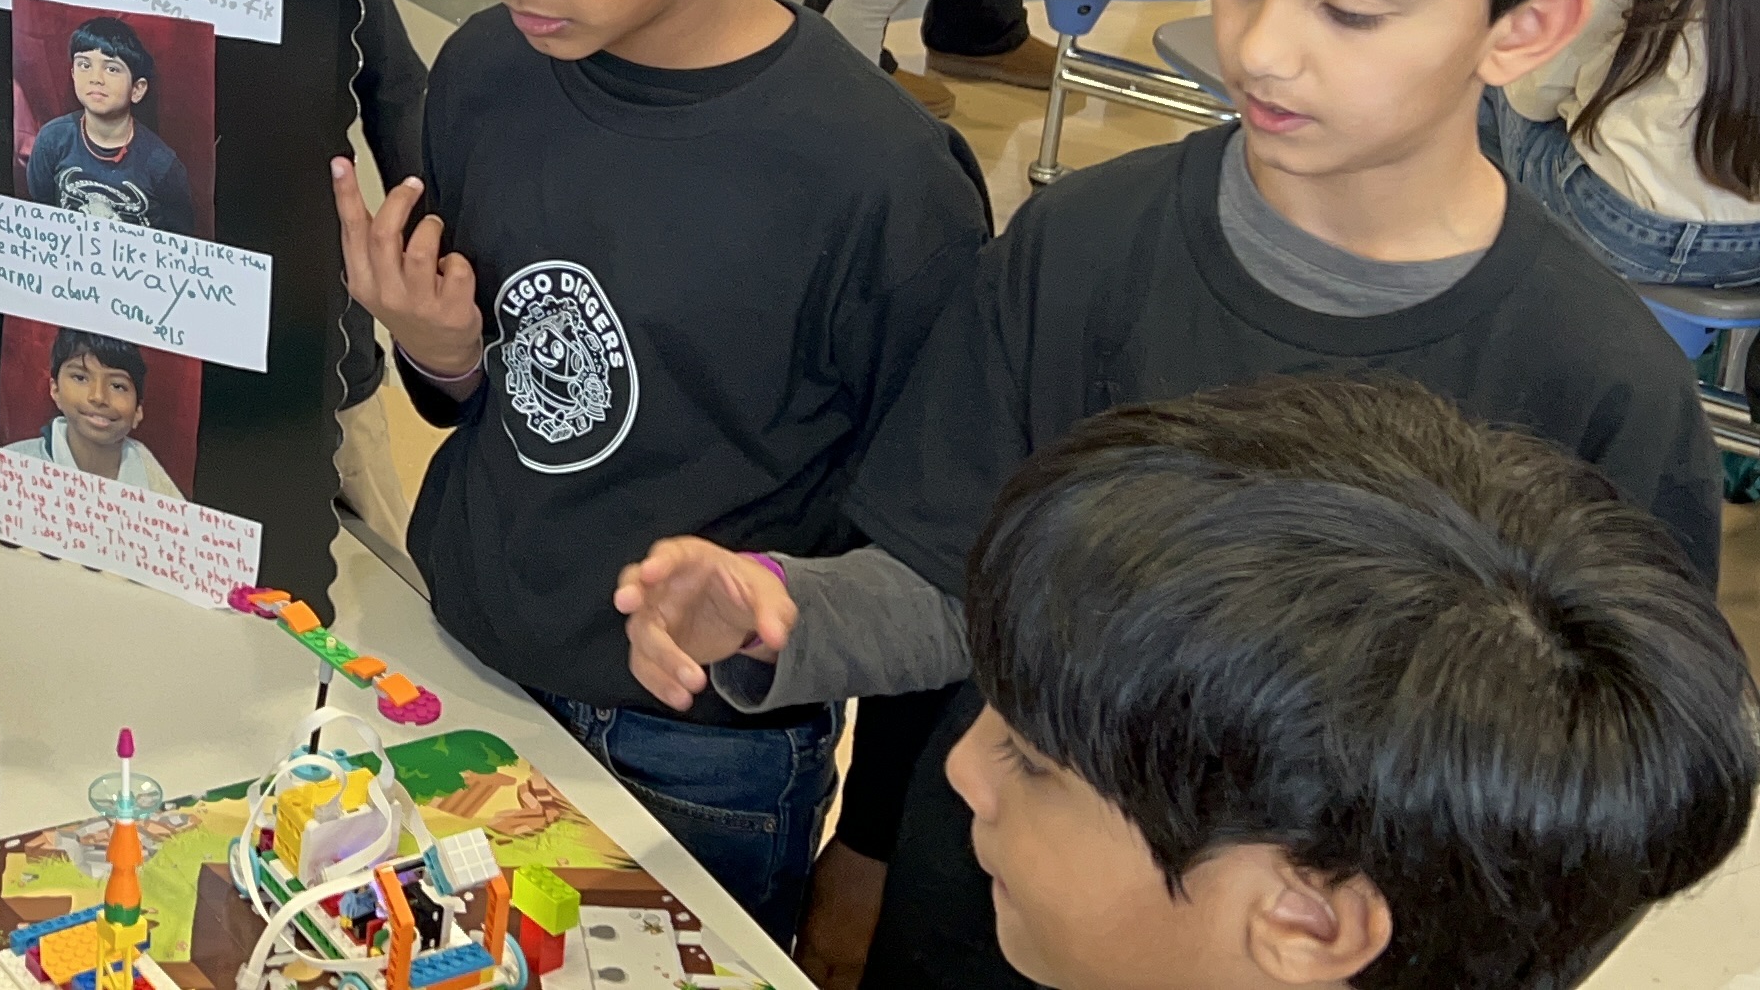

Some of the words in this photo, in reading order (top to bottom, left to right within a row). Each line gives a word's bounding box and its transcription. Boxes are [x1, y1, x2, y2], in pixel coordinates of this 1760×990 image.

[112, 239, 147, 264] like
[156, 249, 214, 279] kinda
[153, 232, 188, 255] and
[205, 244, 234, 264] like
[64, 254, 84, 272] in
[91, 261, 106, 276] a
[51, 277, 101, 304] about
[501, 273, 553, 317] LEGO
[560, 272, 625, 369] DIGGERS
